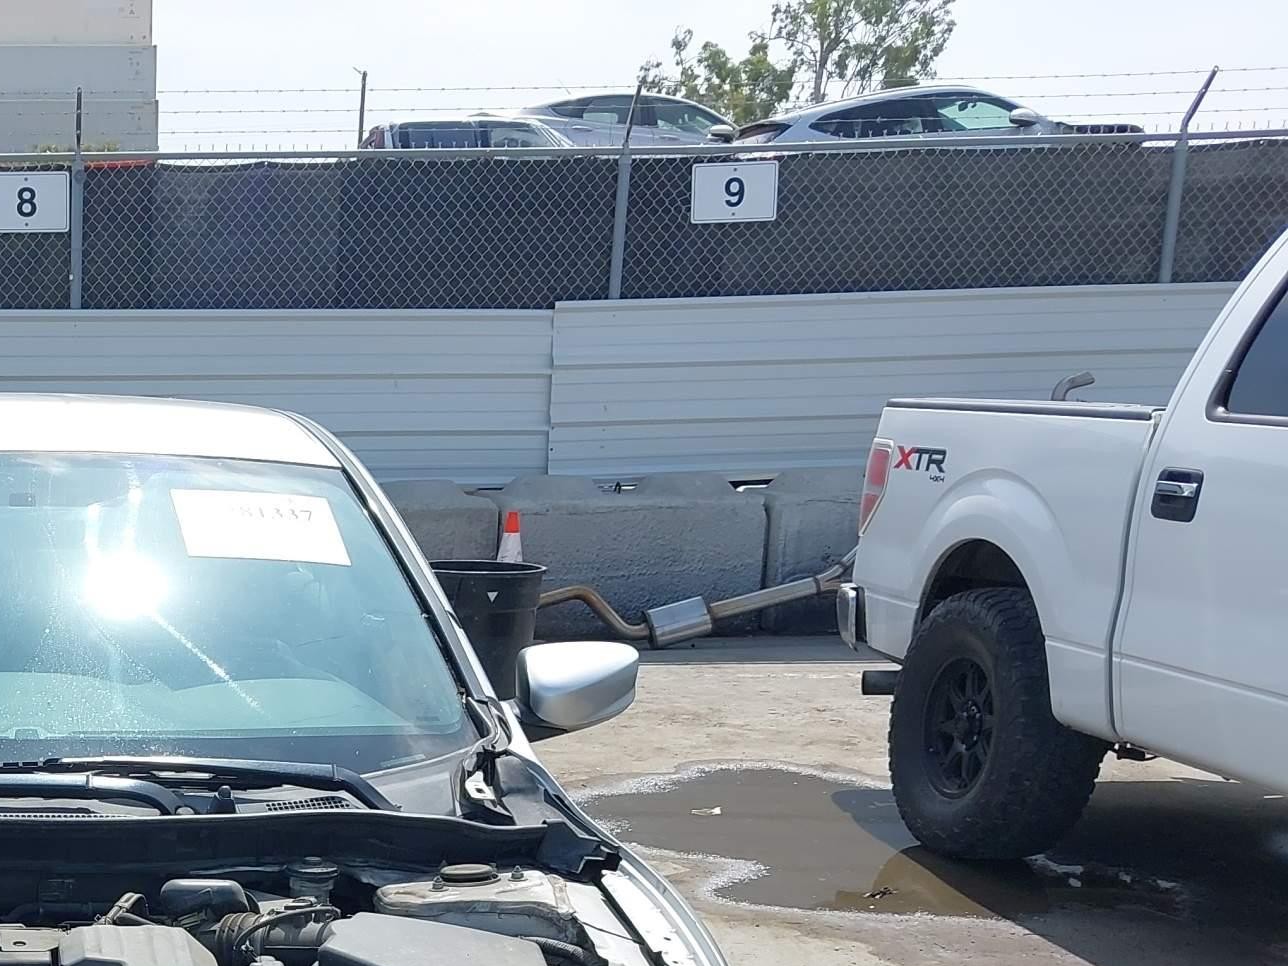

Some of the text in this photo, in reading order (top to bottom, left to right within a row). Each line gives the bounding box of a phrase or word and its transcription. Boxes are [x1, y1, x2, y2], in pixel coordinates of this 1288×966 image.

[16, 187, 37, 218] 8
[724, 177, 745, 208] 9
[893, 445, 947, 473] XTR
